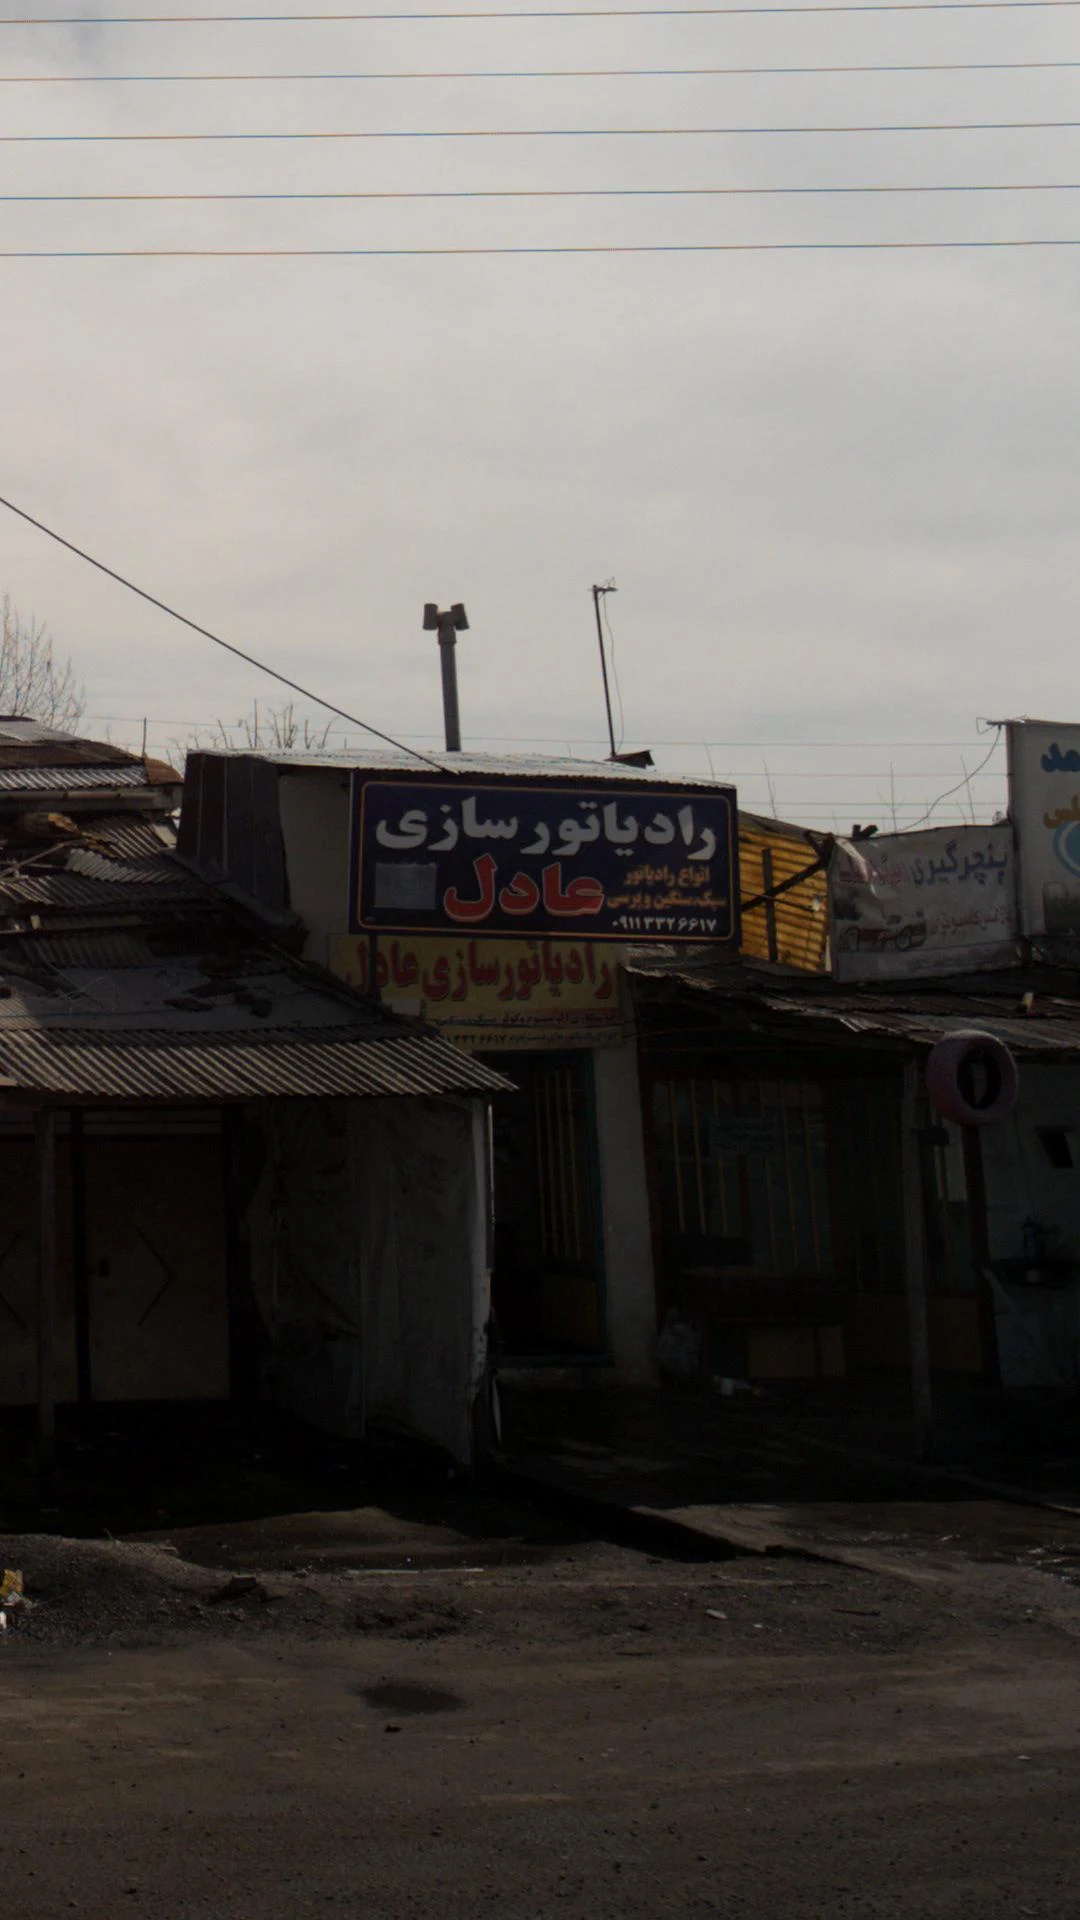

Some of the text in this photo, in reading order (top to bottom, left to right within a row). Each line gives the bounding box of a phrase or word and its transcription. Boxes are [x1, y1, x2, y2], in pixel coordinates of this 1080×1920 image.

[375, 796, 717, 861] رادیاتور سازی
[443, 852, 606, 923] عادل
[623, 863, 711, 888] انواع رادیاتور
[422, 941, 500, 1001] سازی
[498, 940, 613, 1001] رادیاتور
